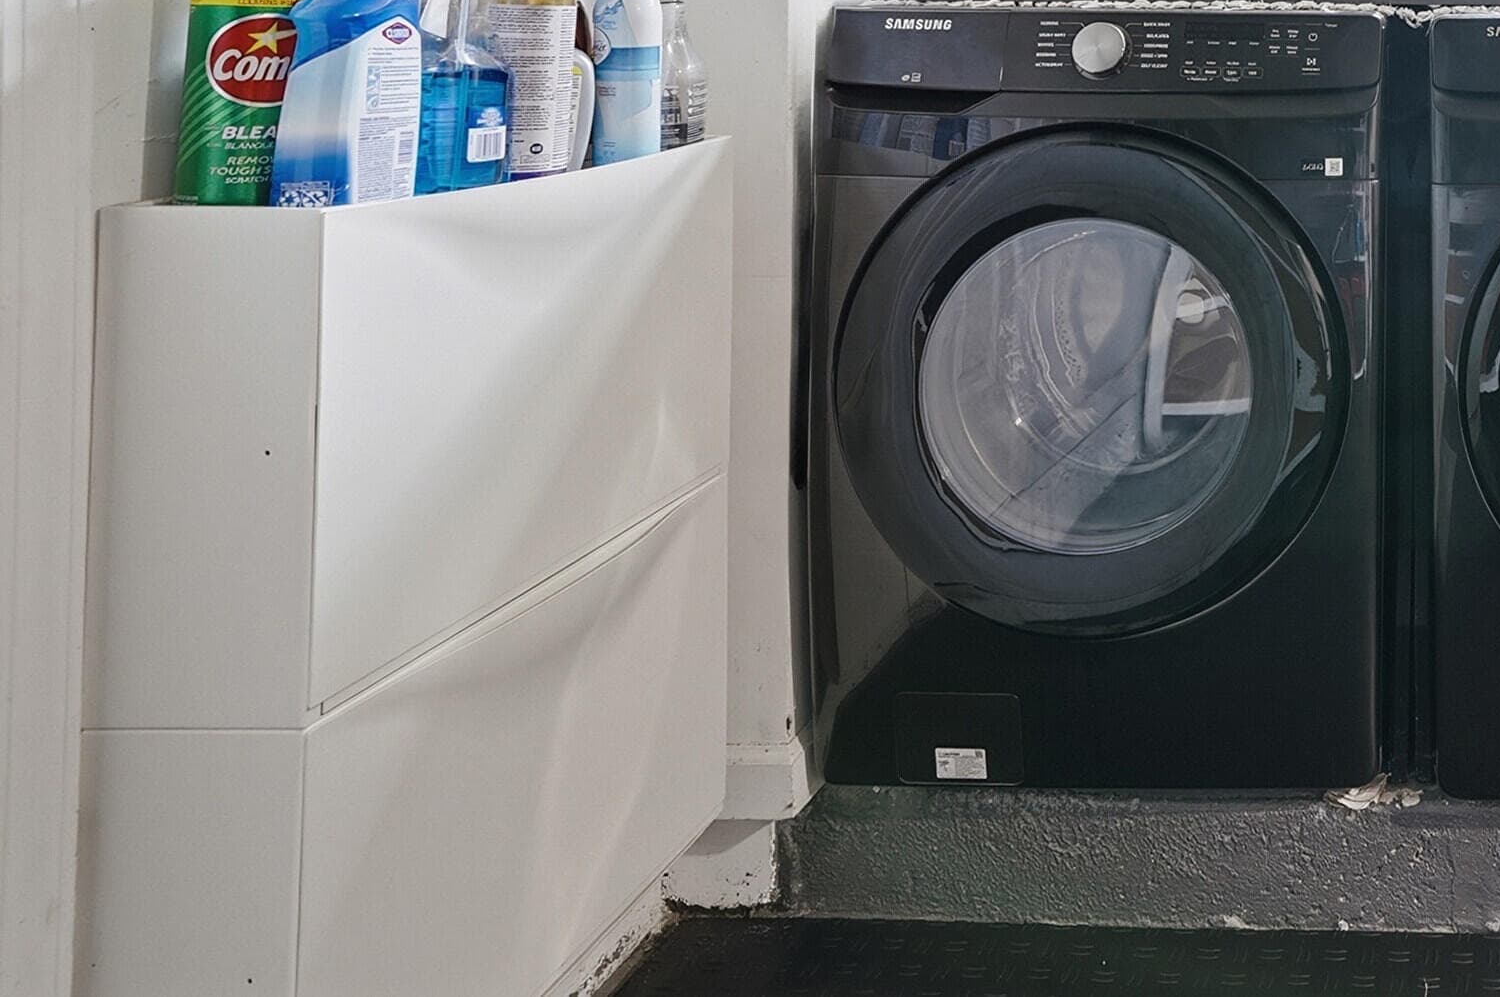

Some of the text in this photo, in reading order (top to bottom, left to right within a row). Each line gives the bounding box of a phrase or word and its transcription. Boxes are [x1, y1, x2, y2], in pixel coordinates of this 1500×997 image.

[884, 18, 952, 31] SAMSUNG
[213, 49, 291, 82] Com
[227, 155, 273, 166] REMO
